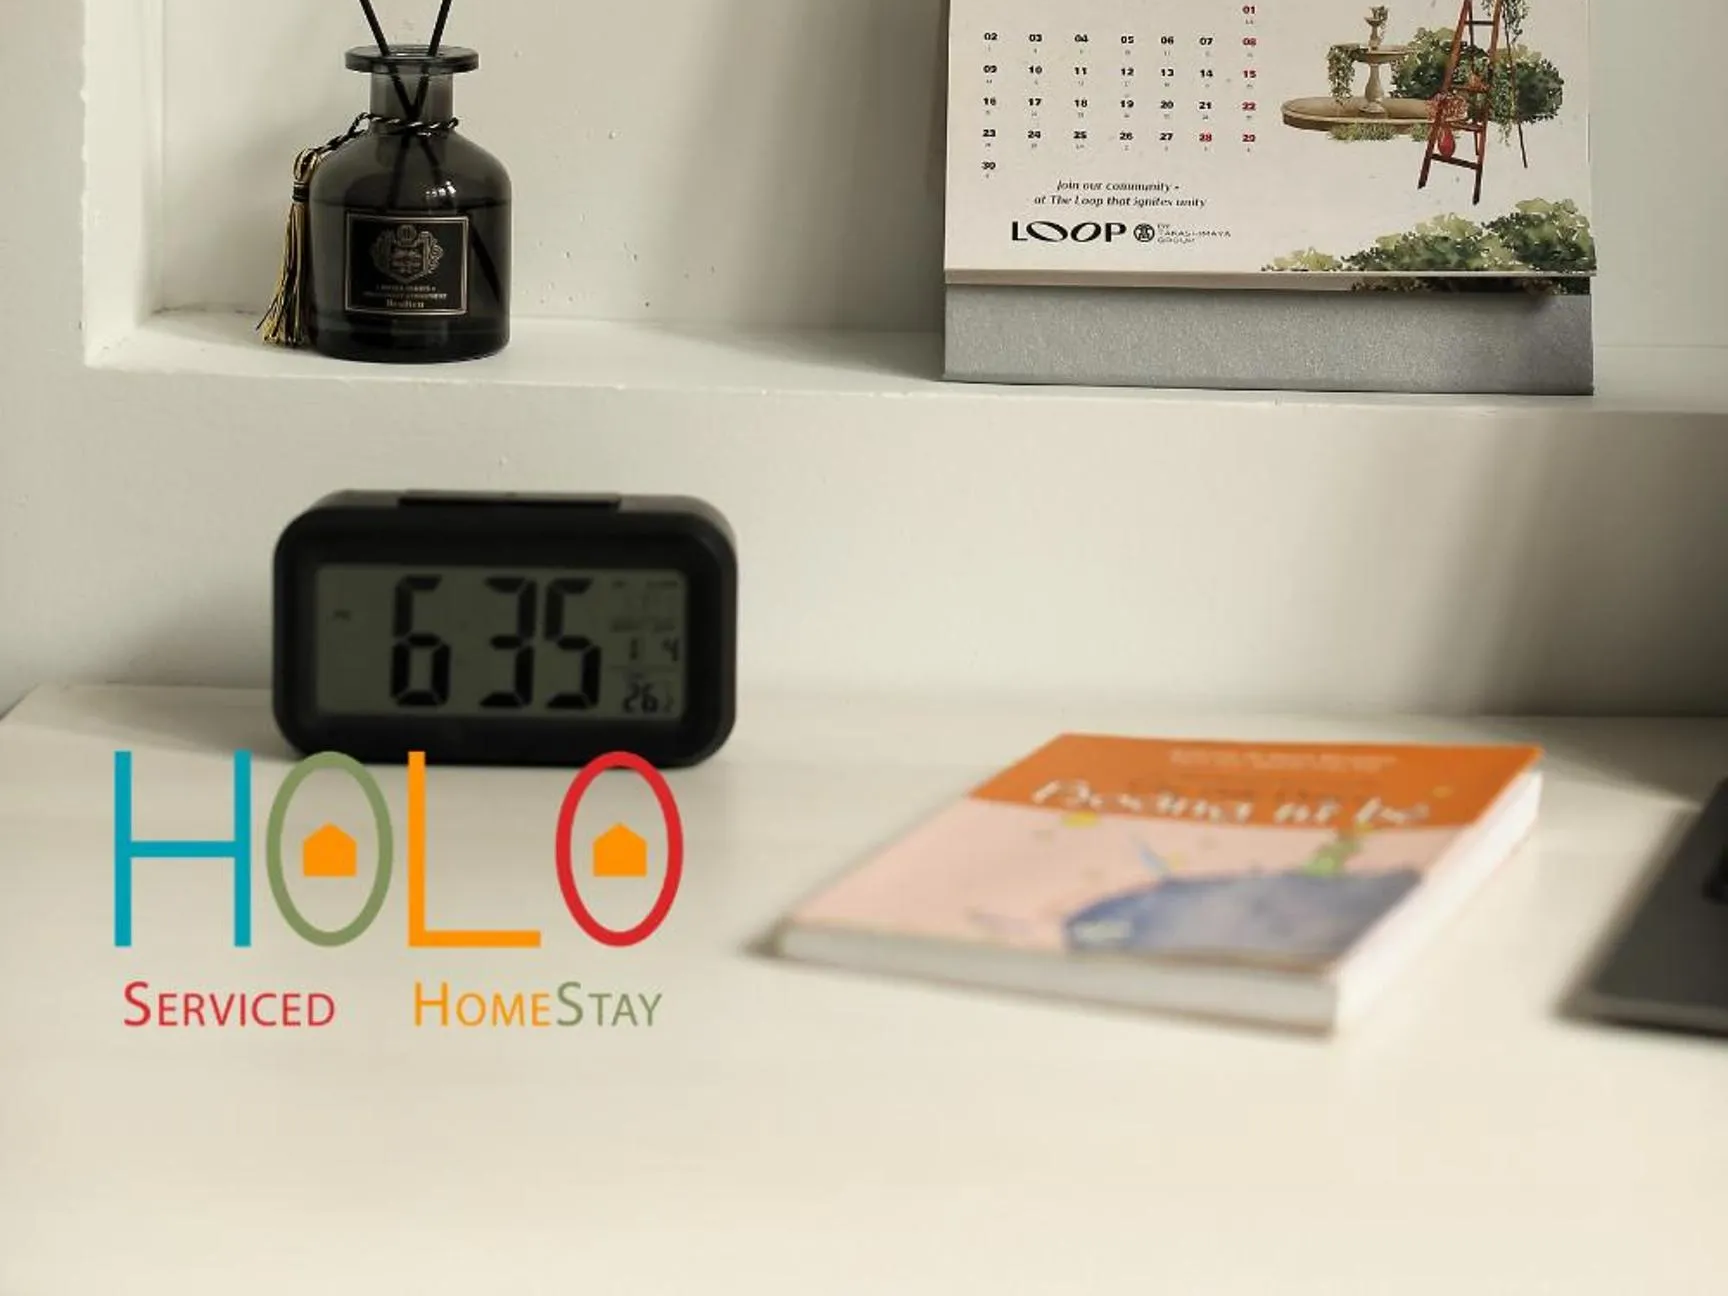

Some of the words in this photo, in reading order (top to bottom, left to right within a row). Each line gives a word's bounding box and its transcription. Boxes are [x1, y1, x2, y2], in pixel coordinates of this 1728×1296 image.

[1241, 4, 1257, 15] 01
[983, 31, 999, 41] 02
[1027, 33, 1043, 43] 03
[1073, 33, 1090, 44] 04
[1120, 35, 1135, 45] 05
[1160, 35, 1175, 46] 06
[1198, 36, 1214, 46] 07
[1241, 37, 1257, 48] 08
[982, 64, 998, 74] 09
[1027, 65, 1043, 76] 10
[1073, 66, 1088, 76] 11
[1120, 66, 1135, 77] 12
[1160, 68, 1175, 77] 13
[1199, 68, 1214, 79] 14
[1242, 69, 1257, 79] 15
[982, 96, 997, 107] 16
[1027, 97, 1043, 107] 17
[1073, 97, 1088, 109] 18
[1119, 99, 1135, 109] 19
[1159, 99, 1175, 110] 20
[1198, 100, 1213, 110] 21
[1241, 101, 1257, 112] 22
[981, 128, 997, 138] 23
[1027, 129, 1042, 140] 24
[1072, 130, 1088, 141] 25
[1119, 130, 1135, 141] 26
[1158, 132, 1174, 142] 27
[1198, 131, 1213, 143] 28
[1241, 133, 1257, 143] 29
[980, 160, 997, 171] 30
[1056, 179, 1080, 191] Join
[1083, 182, 1103, 191] our
[1106, 180, 1171, 193] community
[1050, 194, 1072, 205] The
[1075, 195, 1103, 208] Loop
[1107, 196, 1131, 207] that
[1133, 196, 1173, 208] ignites
[1176, 197, 1207, 209] unity
[1011, 220, 1128, 243] LOOP
